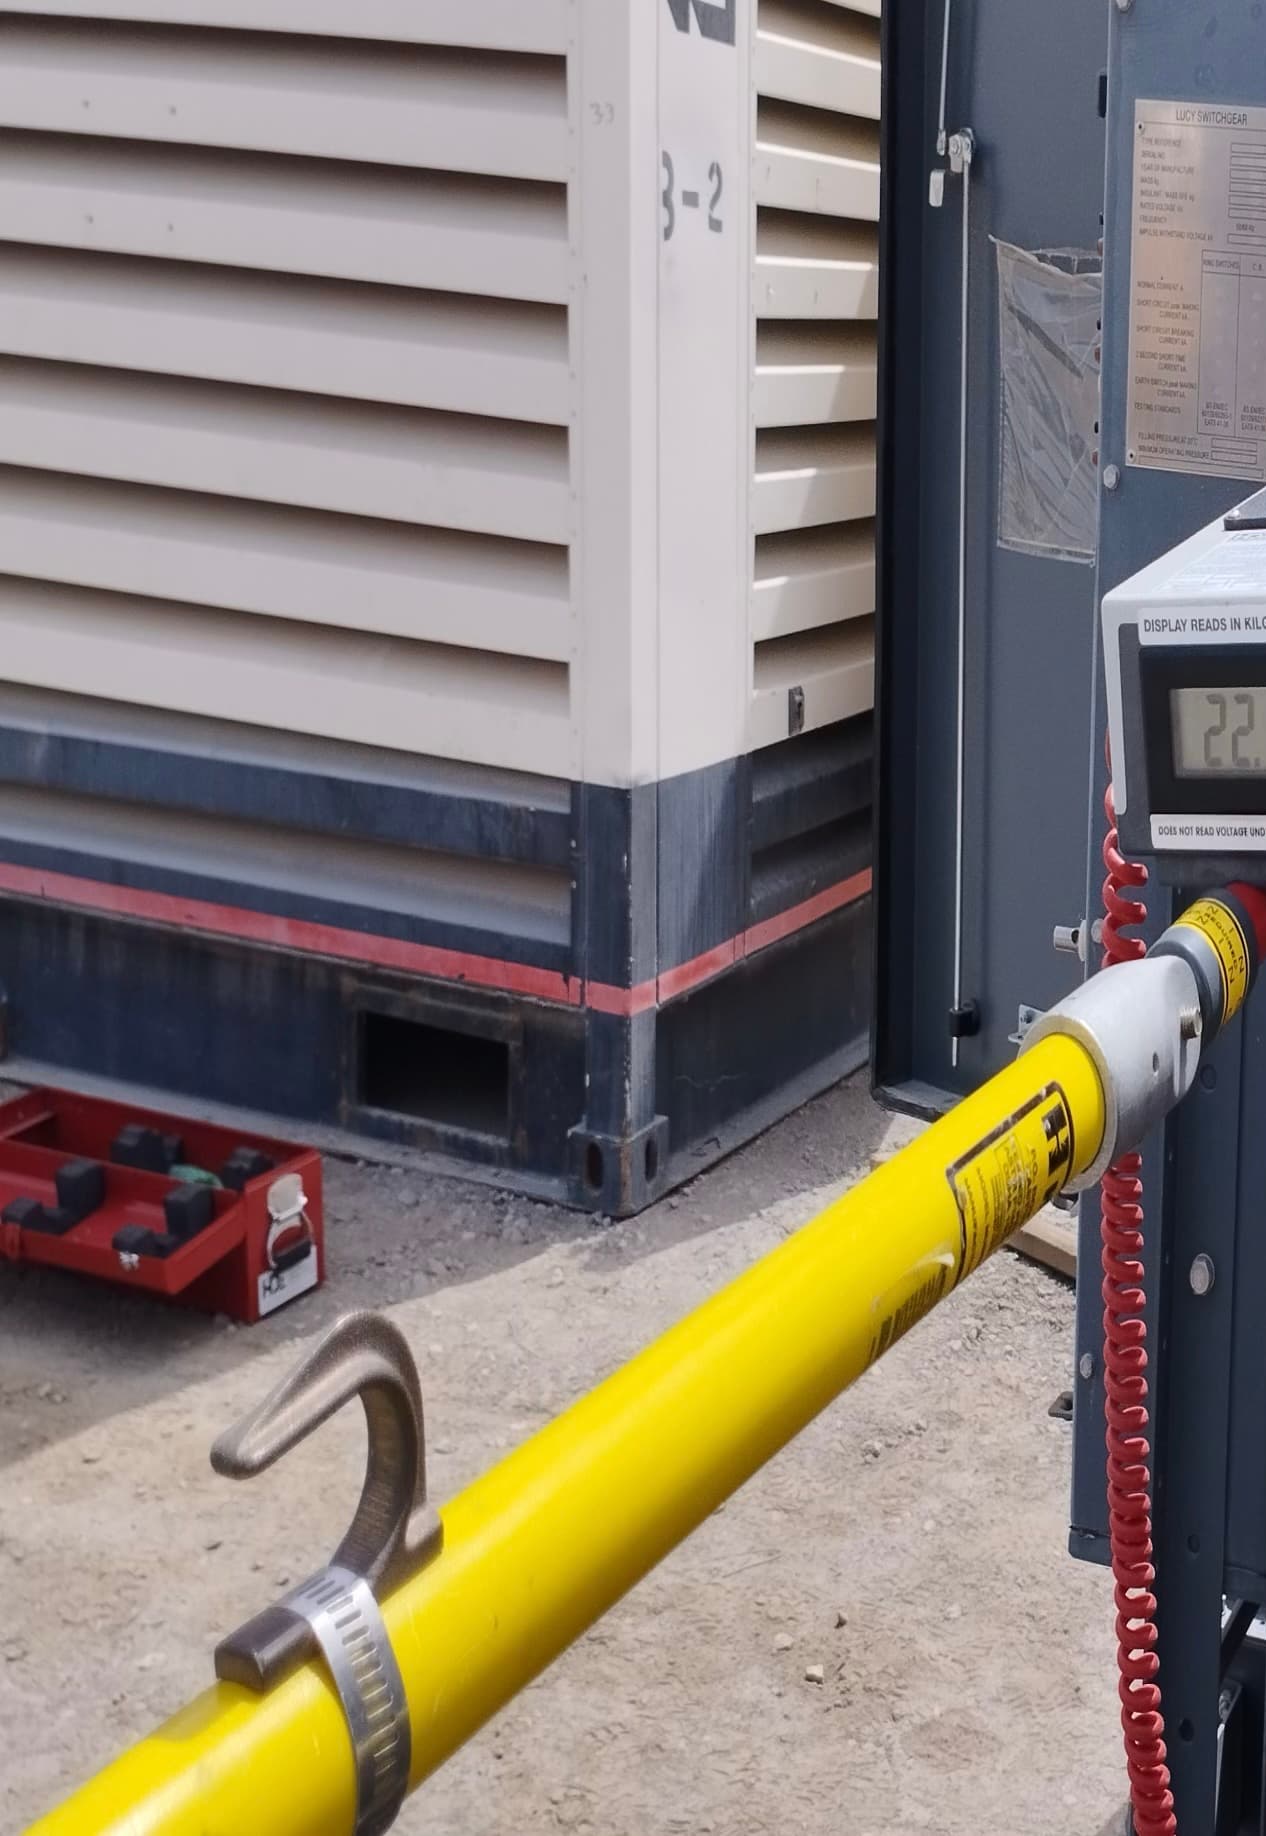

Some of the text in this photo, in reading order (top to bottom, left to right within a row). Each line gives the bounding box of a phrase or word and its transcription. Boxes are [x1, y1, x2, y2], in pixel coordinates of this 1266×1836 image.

[1175, 109, 1248, 127] LUCY SWITCHGEAR
[1143, 619, 1187, 633] DISPLAY
[1190, 617, 1227, 632] READS
[1230, 616, 1241, 631] IN
[1158, 825, 1178, 836] DOES
[1179, 825, 1194, 836] NOT
[1196, 826, 1215, 837] READ
[1216, 826, 1248, 838] VOLTAGE
